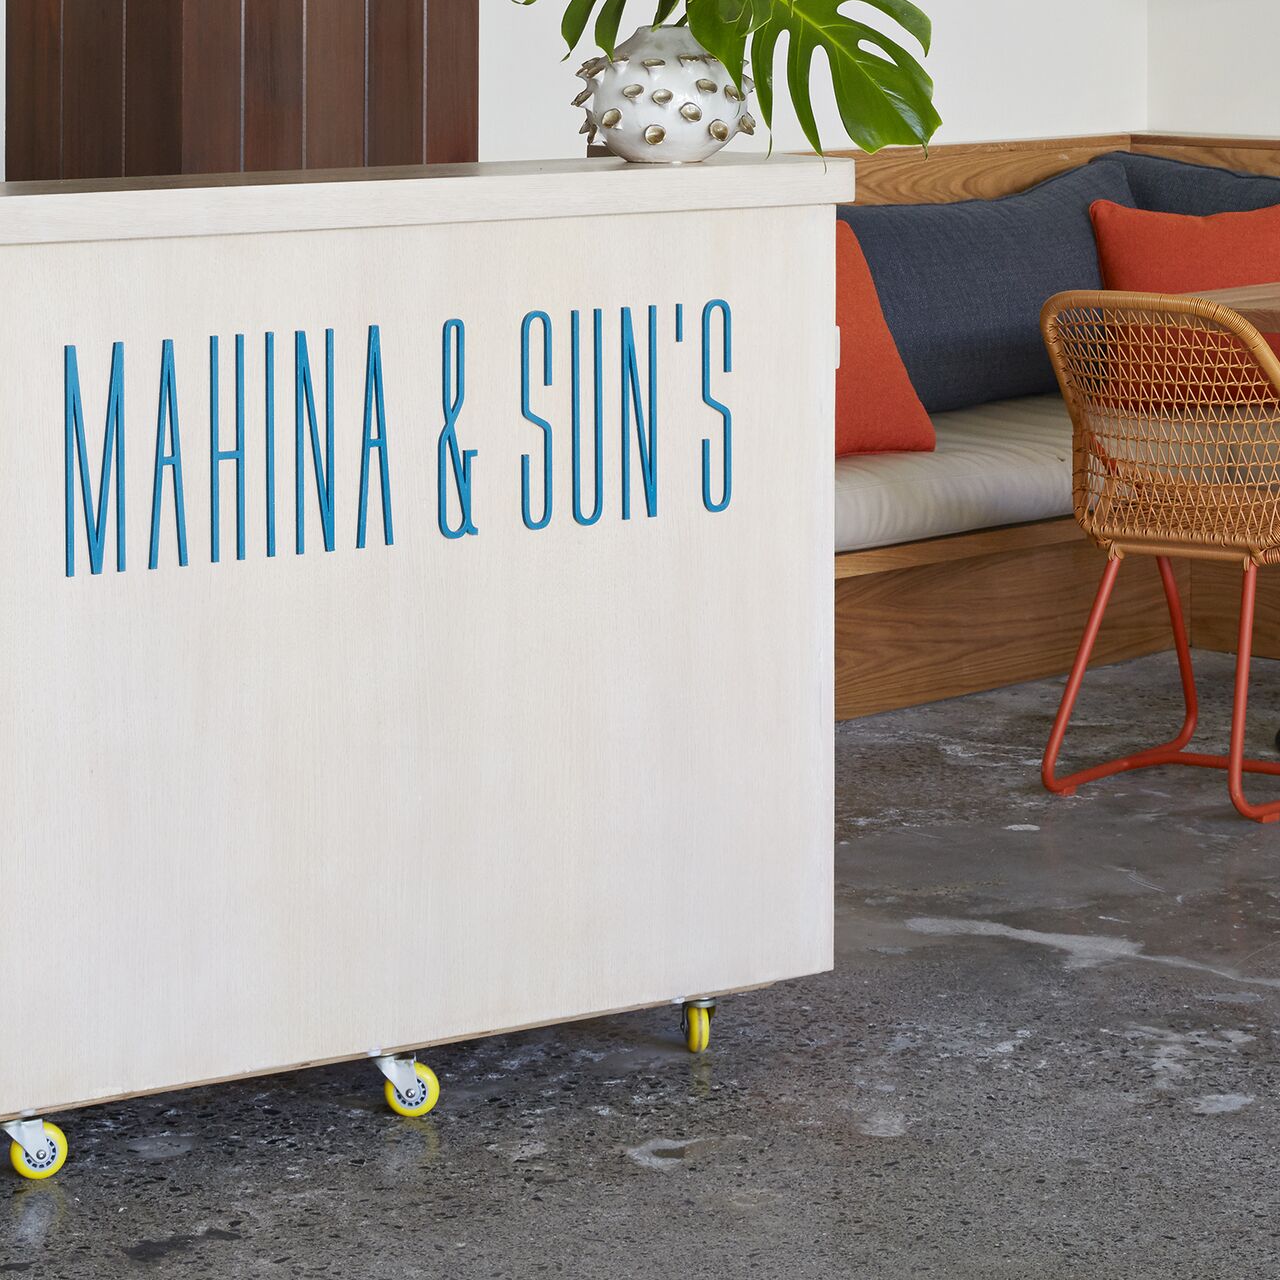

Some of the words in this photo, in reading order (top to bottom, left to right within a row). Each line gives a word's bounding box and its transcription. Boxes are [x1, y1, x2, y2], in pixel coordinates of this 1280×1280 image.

[64, 324, 395, 578] MAHINA
[437, 318, 479, 539] &
[520, 299, 733, 531] SUN'S
